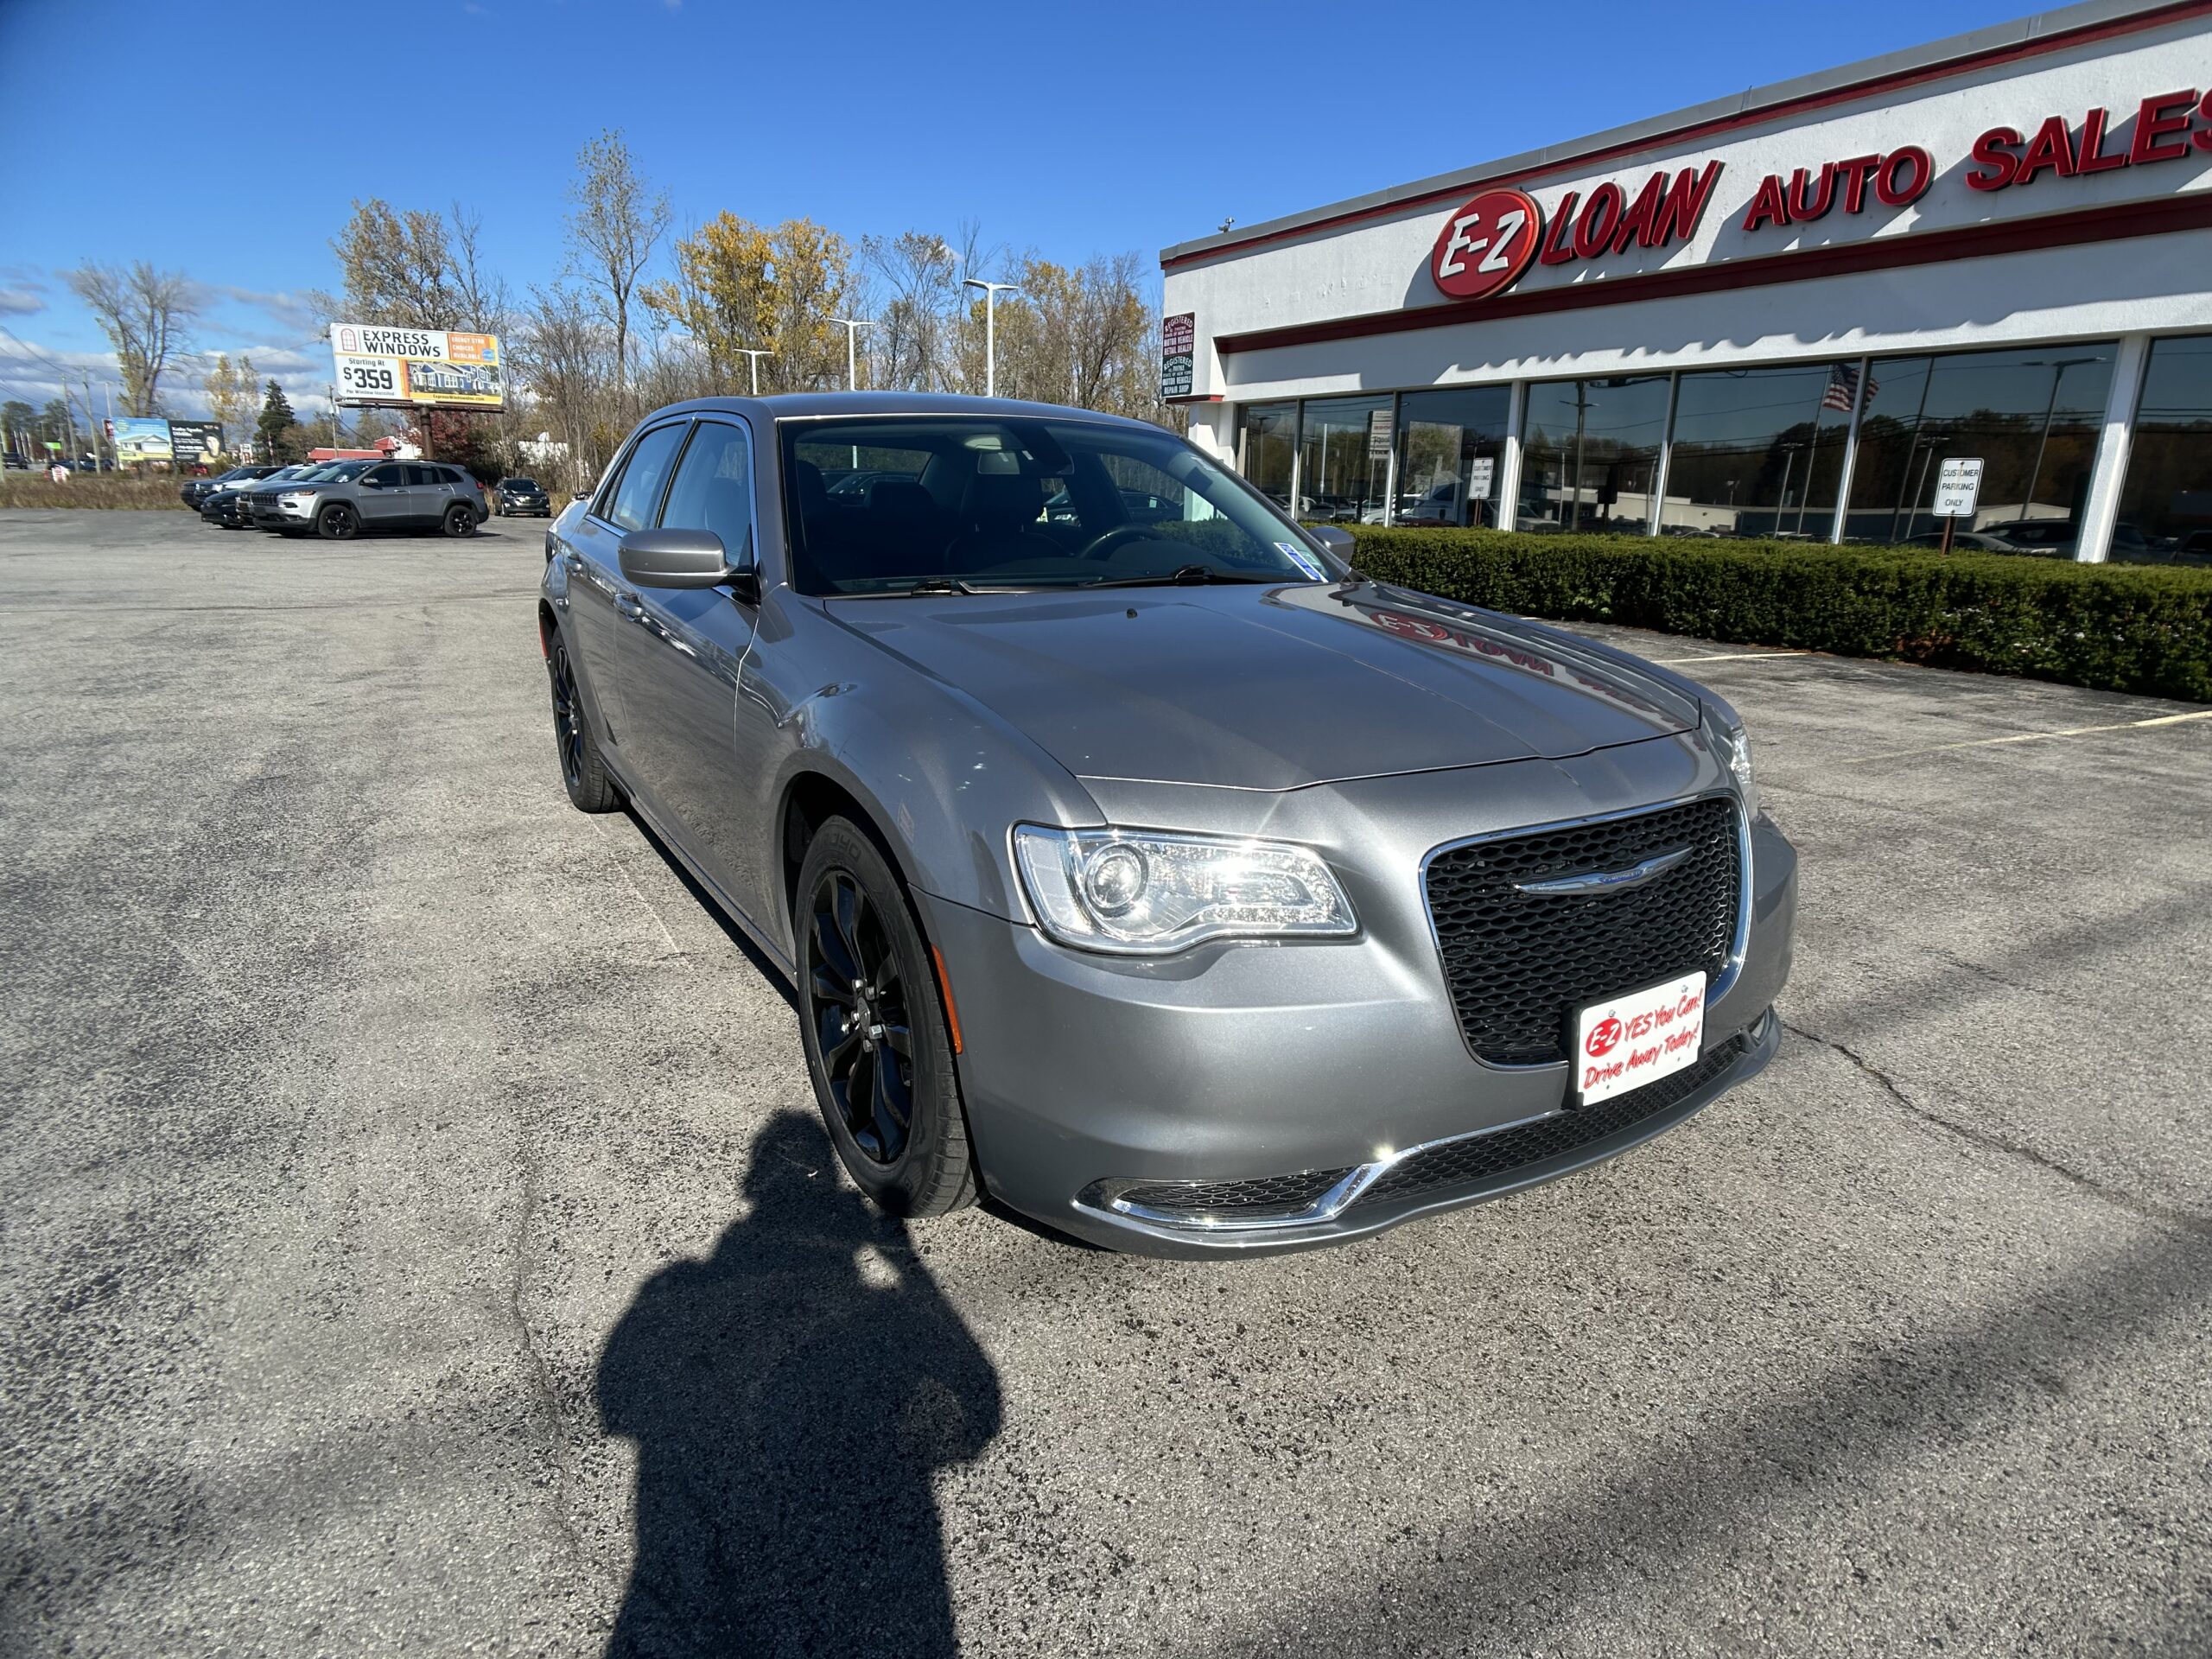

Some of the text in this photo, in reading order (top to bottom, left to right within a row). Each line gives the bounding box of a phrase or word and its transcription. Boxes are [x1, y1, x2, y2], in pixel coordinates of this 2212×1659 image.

[1540, 159, 1726, 264] LOAN
[1742, 144, 1936, 231] AUTO
[1439, 210, 1526, 279] E-Z
[1164, 315, 1193, 333] REGISTERED
[363, 329, 429, 345] EXPRESS
[1164, 334, 1192, 346] MOTOR VEHICLE
[364, 341, 441, 358] WINDOWS
[1164, 344, 1192, 355] RETAIL DEALER
[348, 358, 376, 366] Starting
[1163, 355, 1192, 371] REGISTERED
[343, 366, 393, 390] $359
[1176, 375, 1192, 385] VEHICLE
[1164, 385, 1190, 395] REPAIR SHOP
[1589, 987, 1704, 1052] E-Z YES You Can!
[1583, 1020, 1700, 1090] Drive Away Today!
